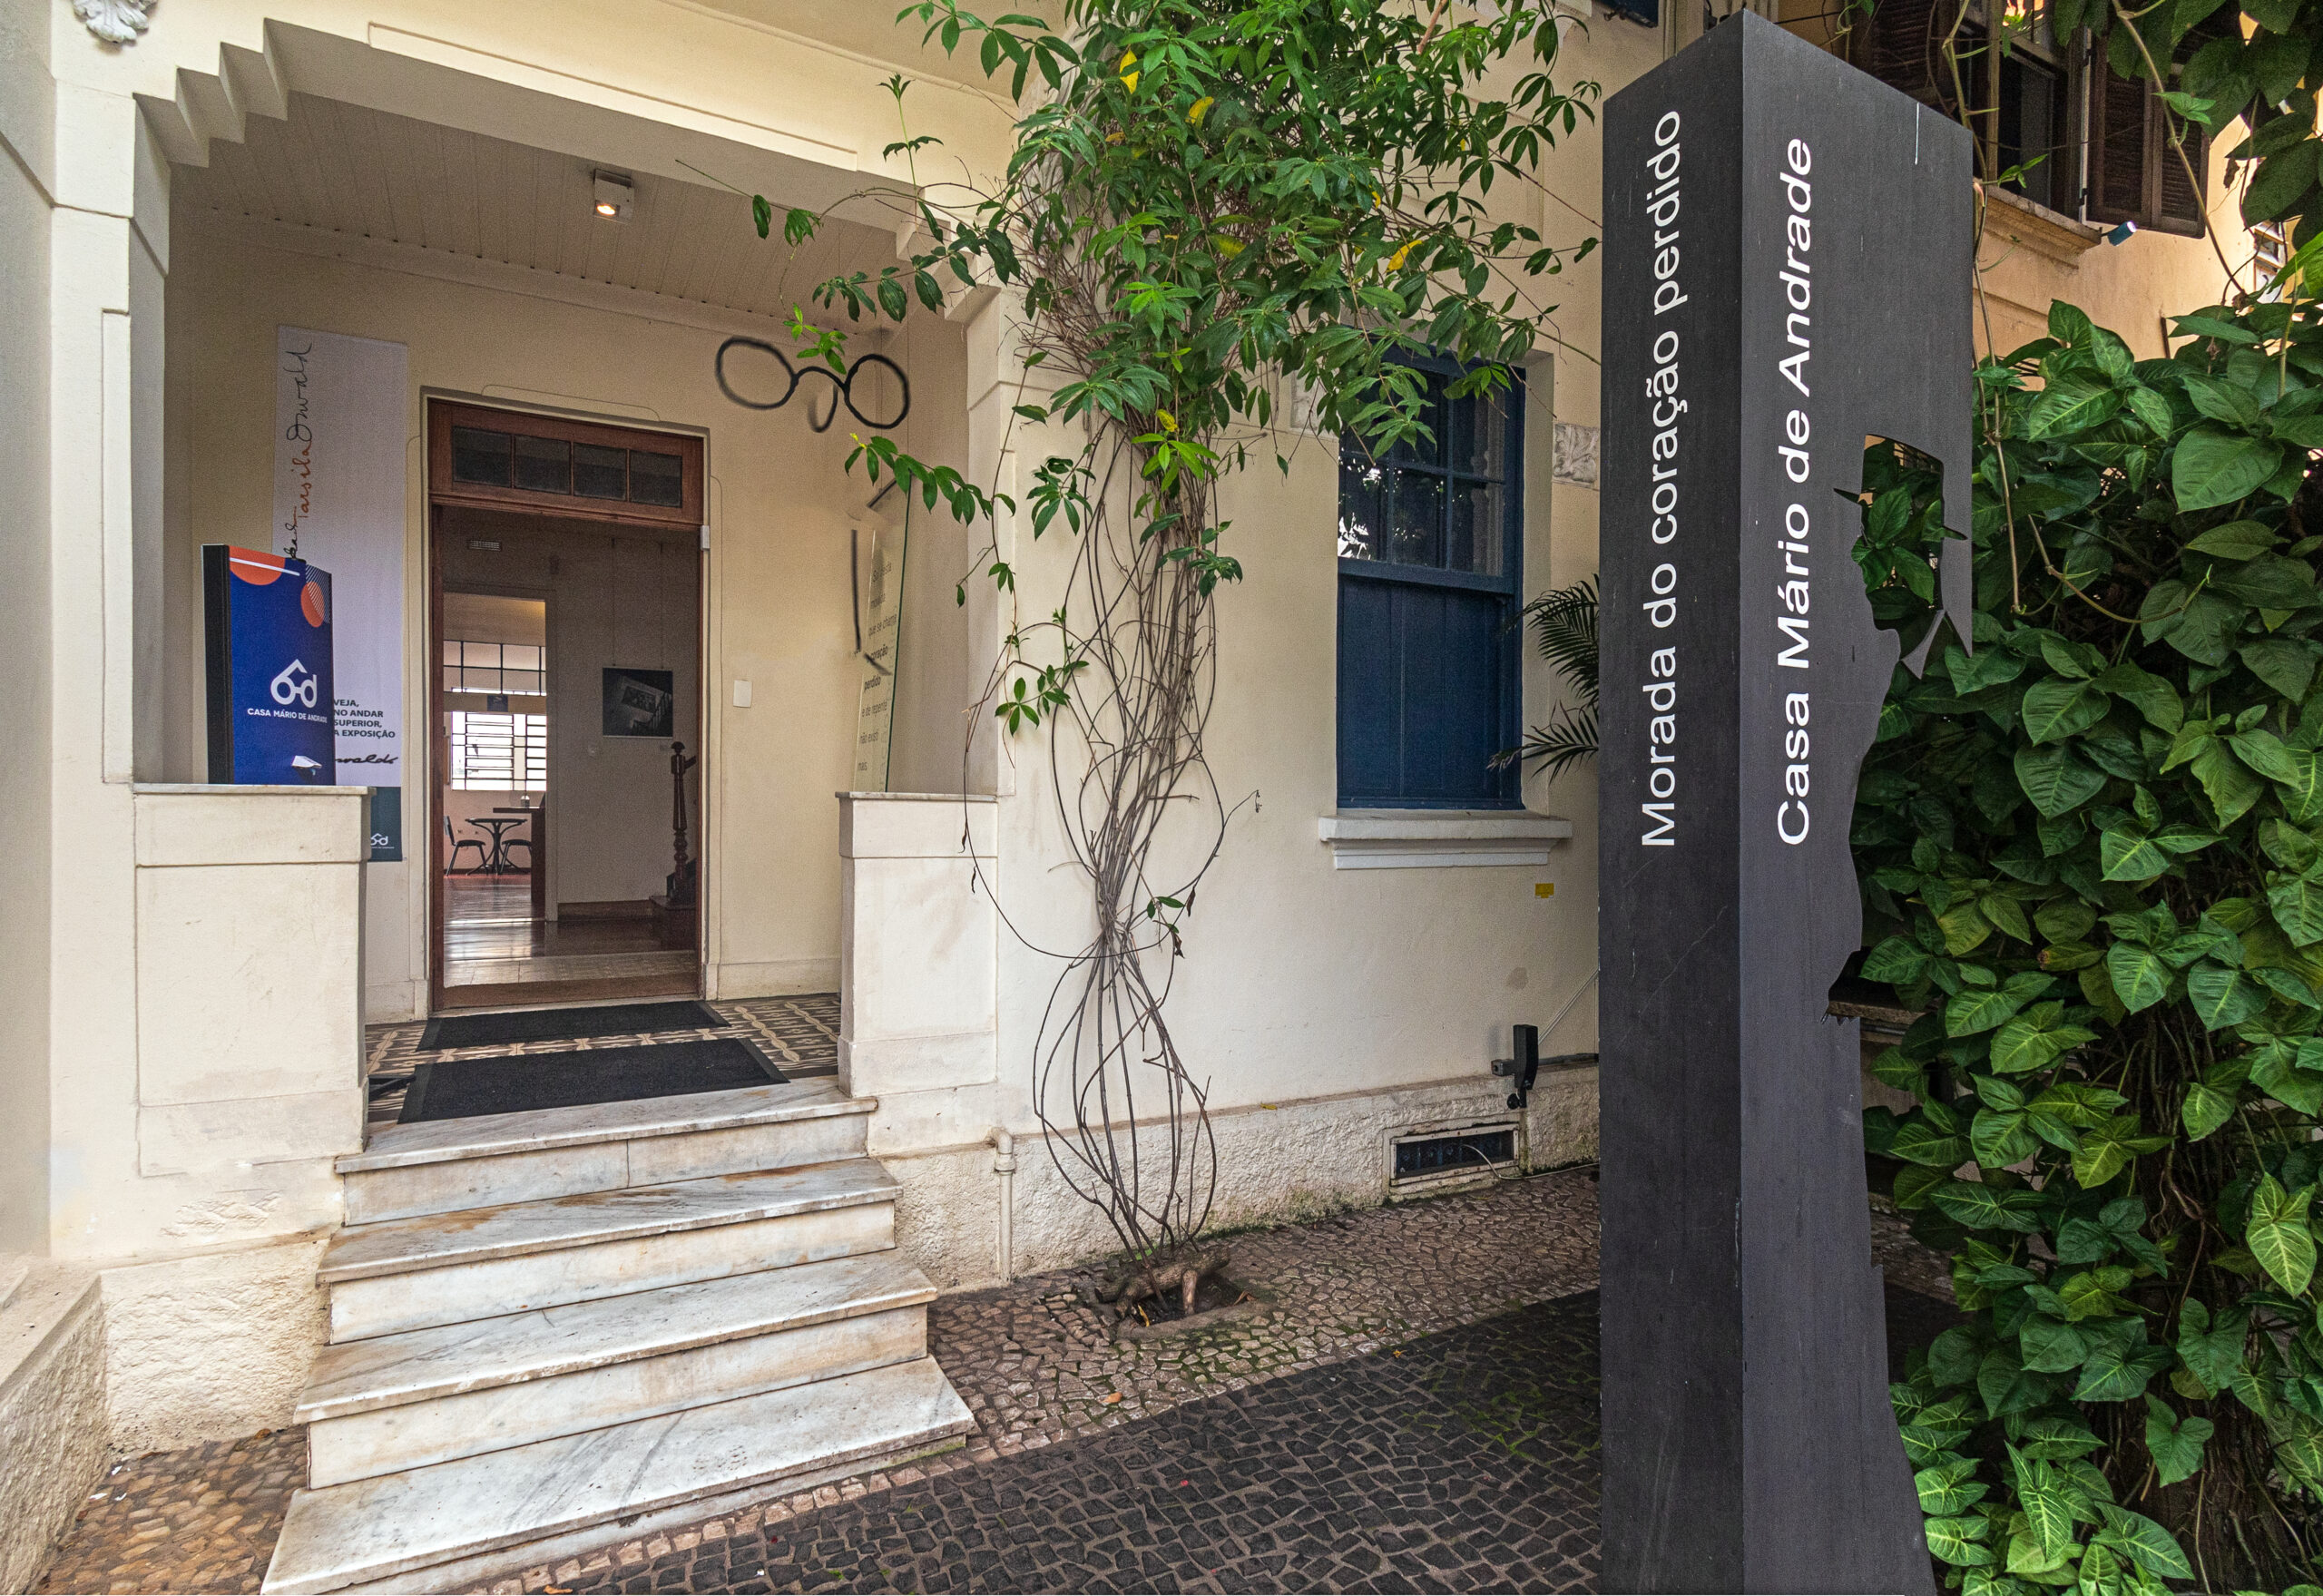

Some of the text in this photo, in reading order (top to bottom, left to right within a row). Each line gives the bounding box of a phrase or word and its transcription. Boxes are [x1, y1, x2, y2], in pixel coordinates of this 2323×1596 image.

[1642, 112, 1687, 845] Morada do coração perdido
[1778, 139, 1811, 845] Casa Mário de Andrade
[334, 699, 359, 708] VEJA,
[247, 708, 271, 717] CASA
[273, 709, 298, 719] MÁRIO
[299, 712, 308, 720] DE
[334, 709, 384, 718] NO ANDAR
[334, 720, 383, 729] SUPERIOR,
[342, 729, 396, 739] EXPOSIÇÃO
